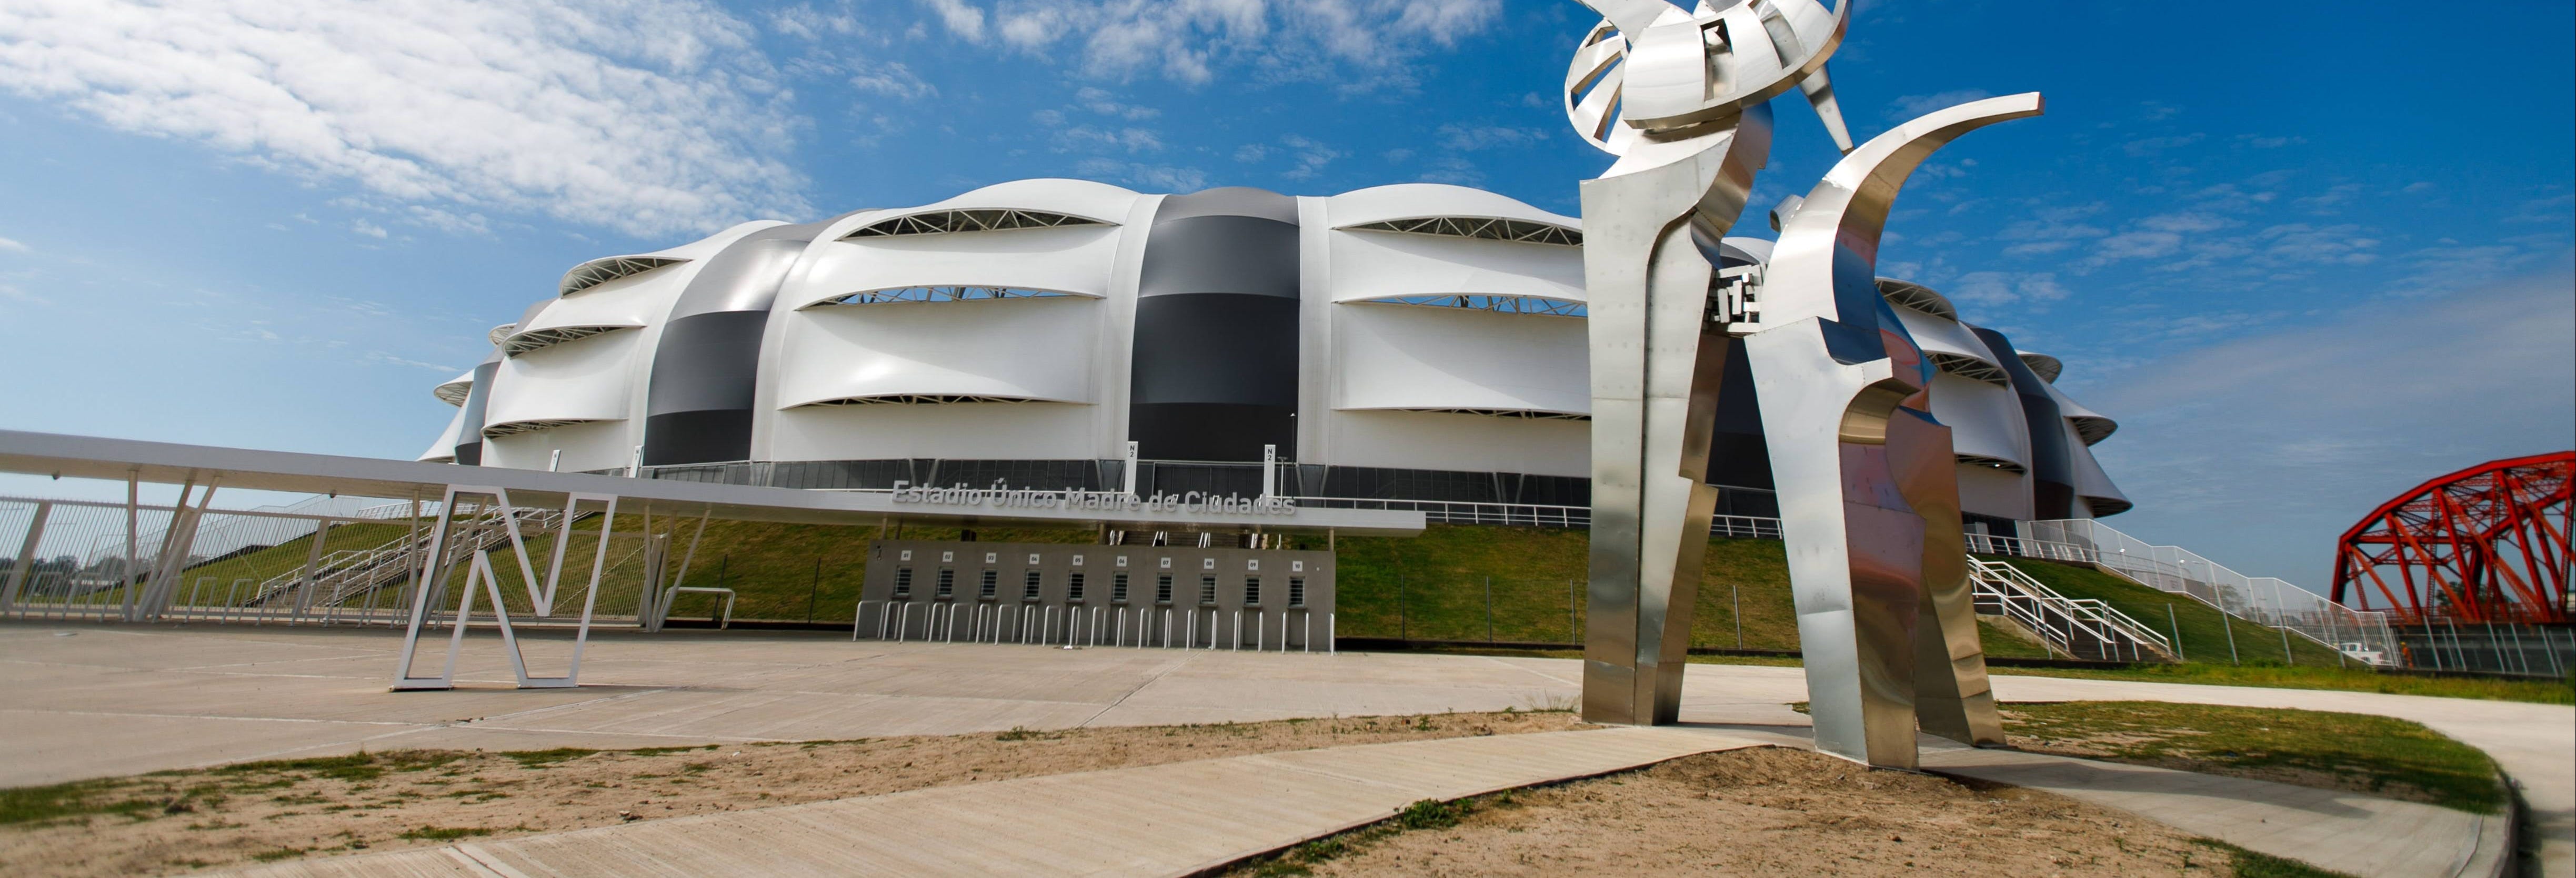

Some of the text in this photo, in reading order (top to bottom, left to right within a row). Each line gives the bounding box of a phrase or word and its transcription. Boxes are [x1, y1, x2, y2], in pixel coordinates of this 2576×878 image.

[893, 478, 1296, 515] Estadio Único Madre de Ciudades
